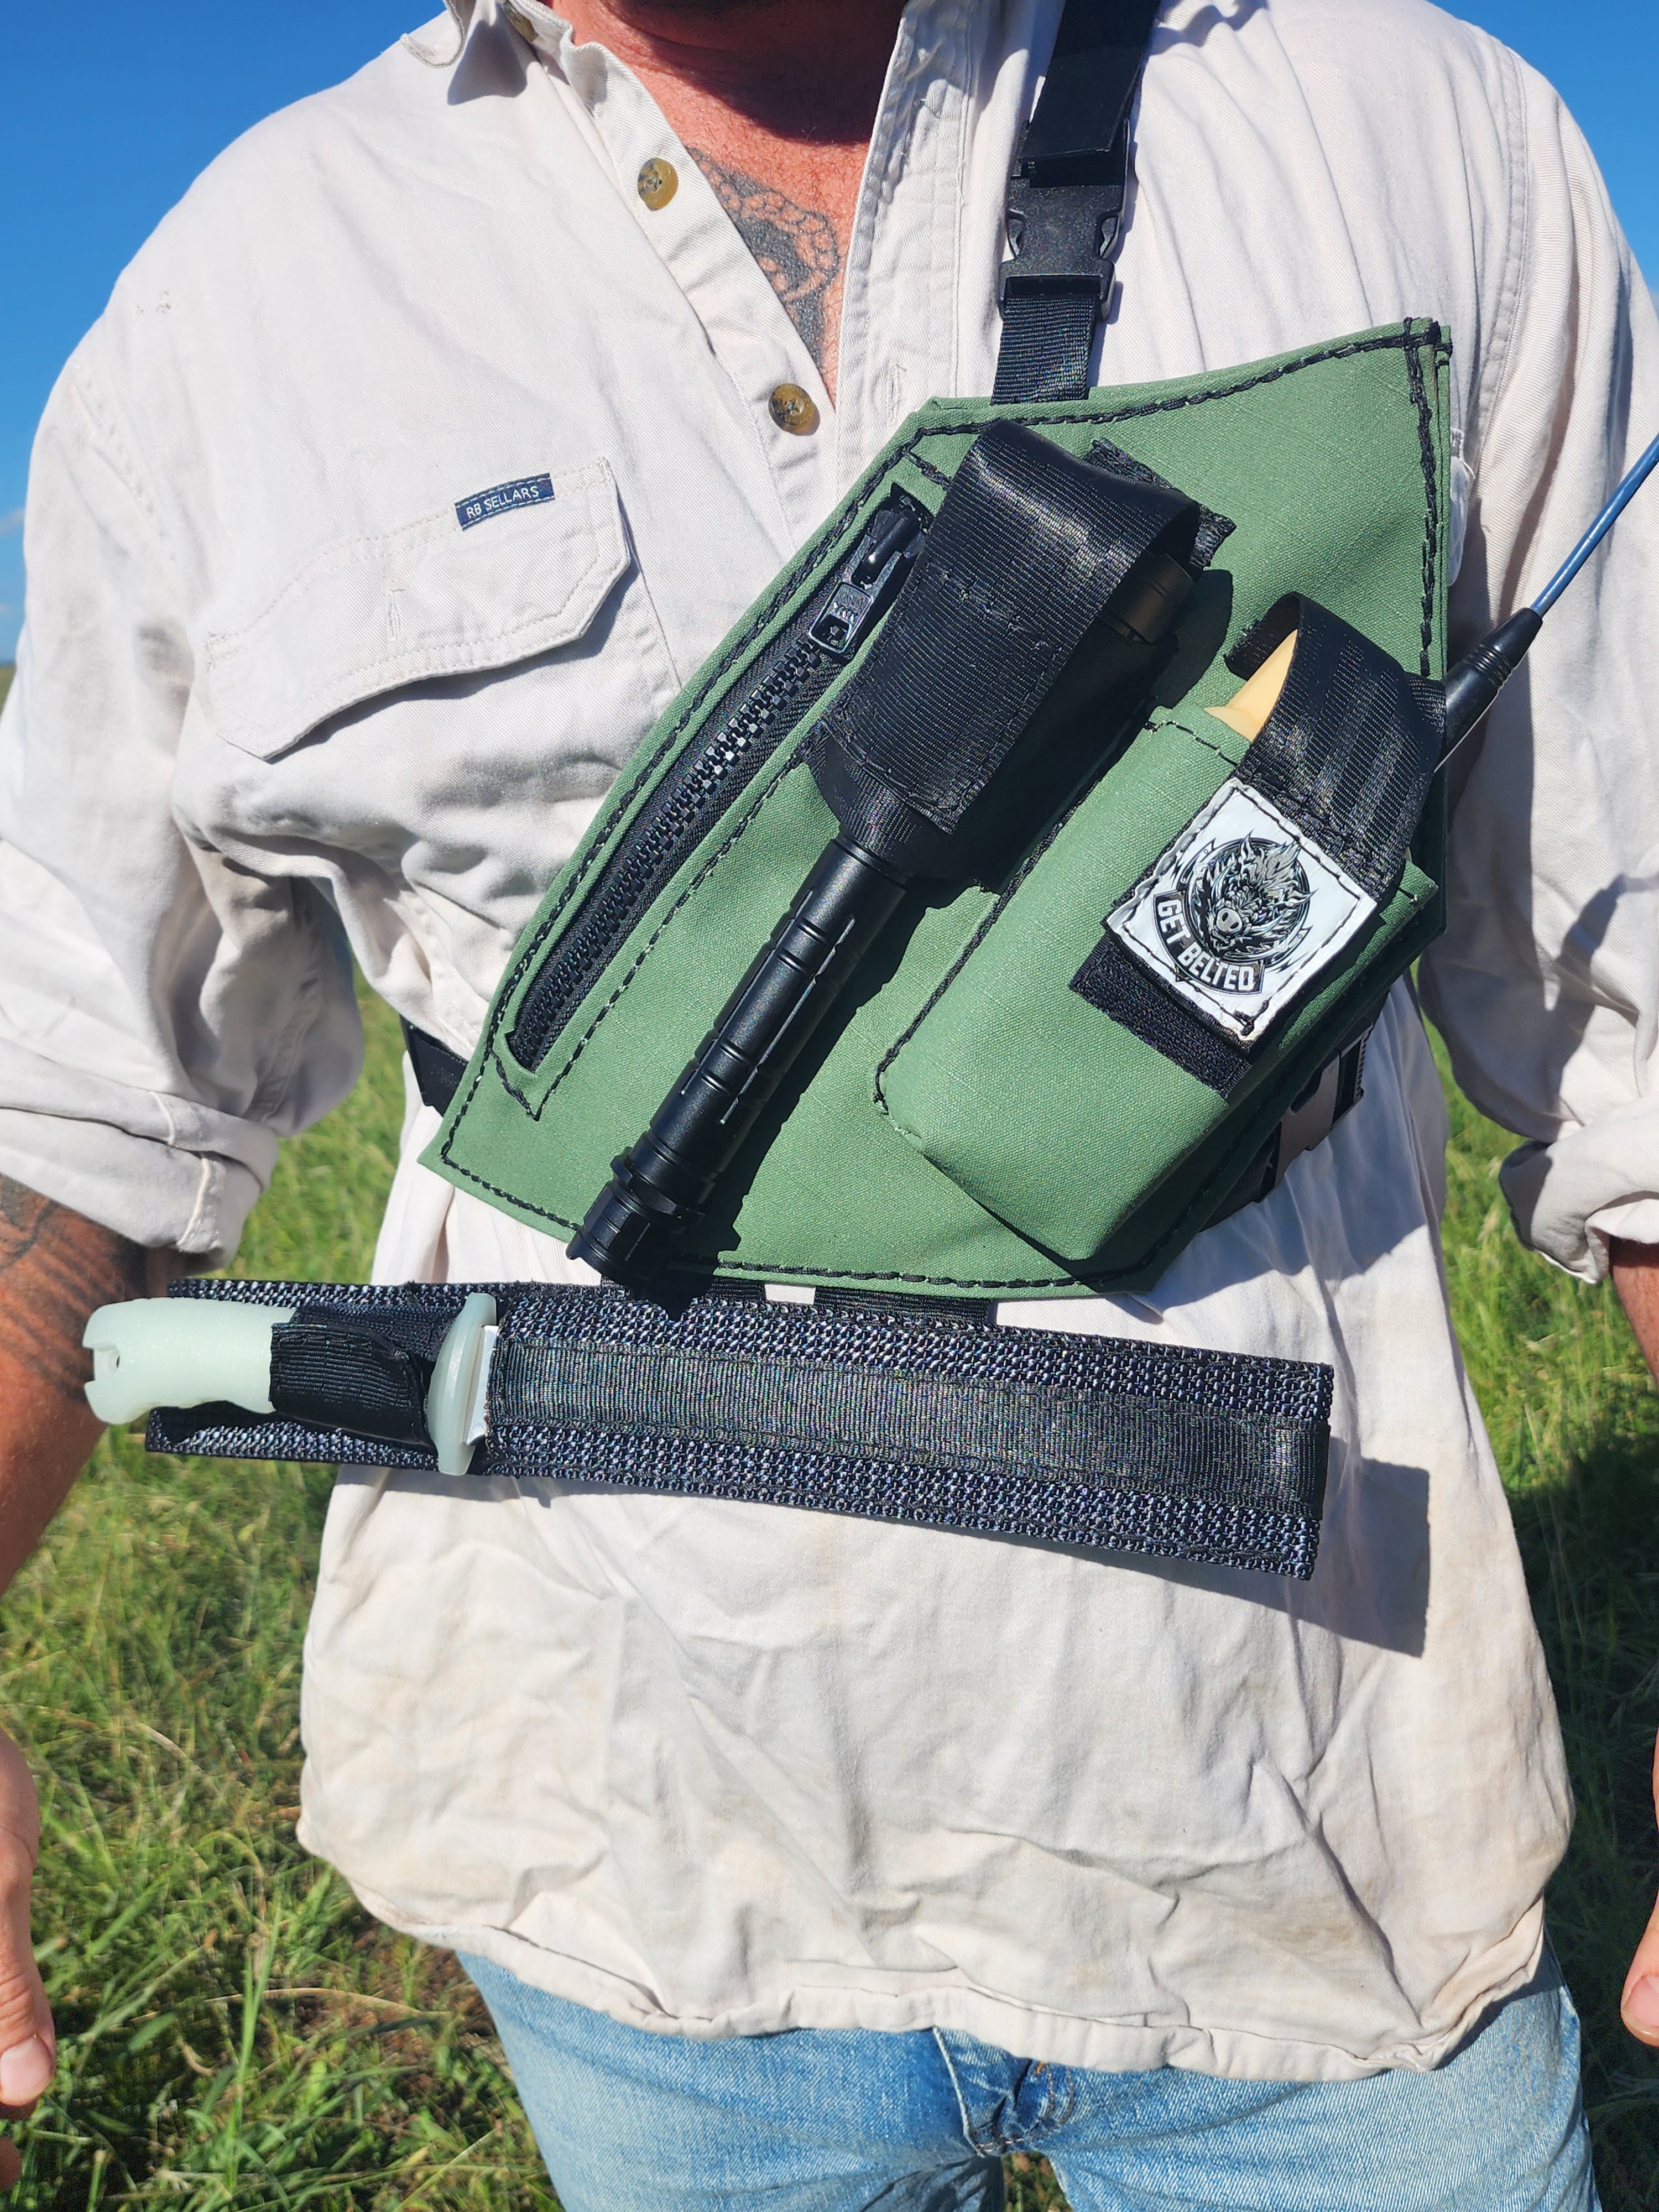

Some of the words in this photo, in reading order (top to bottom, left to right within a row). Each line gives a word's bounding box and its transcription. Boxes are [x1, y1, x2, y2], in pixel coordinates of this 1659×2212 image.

[466, 503, 482, 518] RB
[483, 486, 539, 510] SELLARS
[1158, 899, 1191, 944] GET
[1177, 942, 1255, 990] BELTED
